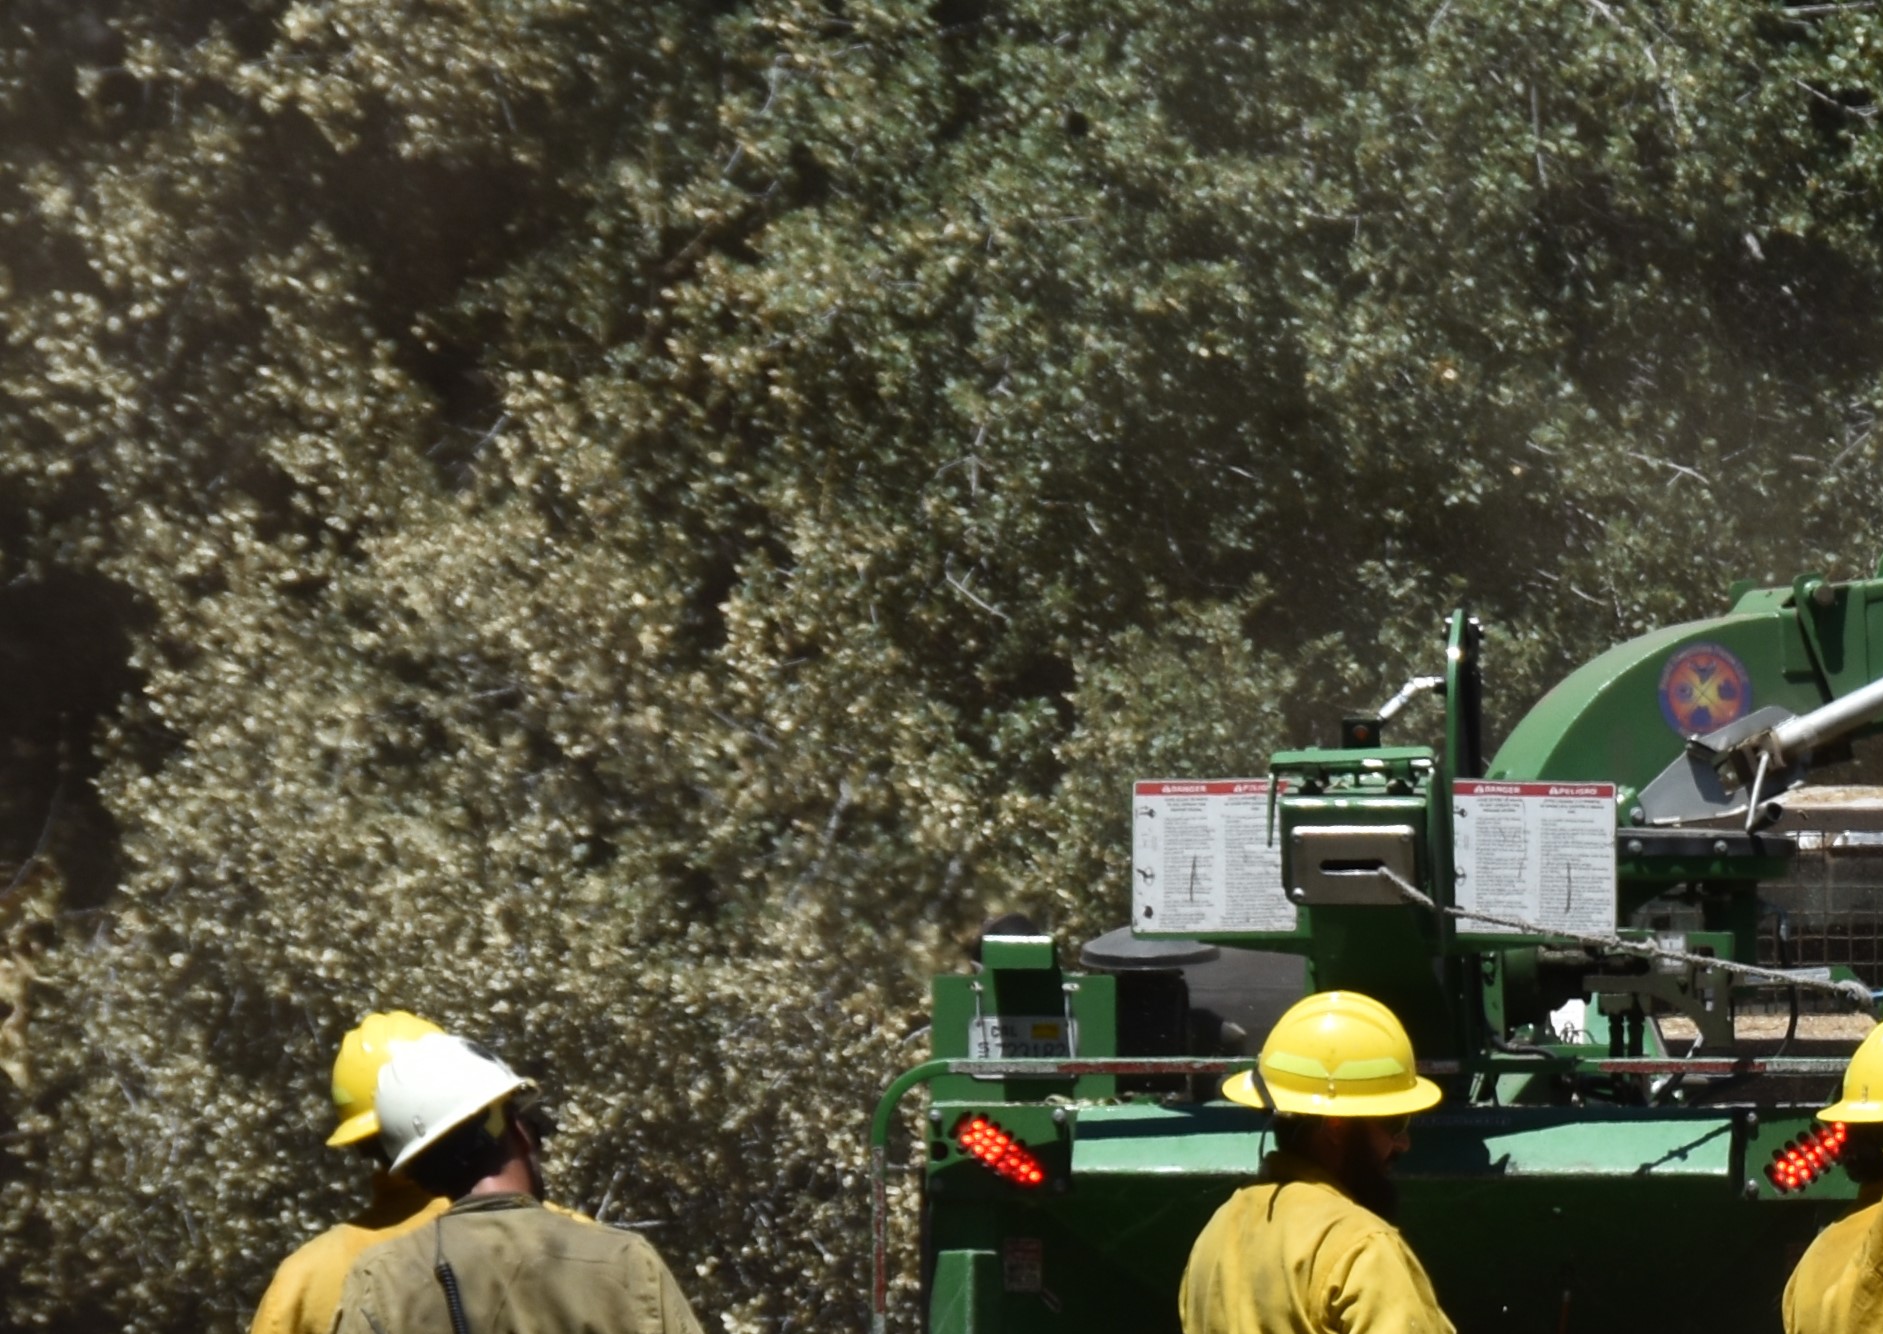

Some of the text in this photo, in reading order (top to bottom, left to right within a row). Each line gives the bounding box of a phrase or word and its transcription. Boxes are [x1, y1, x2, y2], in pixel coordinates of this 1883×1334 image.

[1171, 785, 1207, 793] DANGER
[1484, 786, 1521, 794] DANGER
[1559, 787, 1598, 795] PELIGRO
[991, 1025, 1017, 1037] CAL
